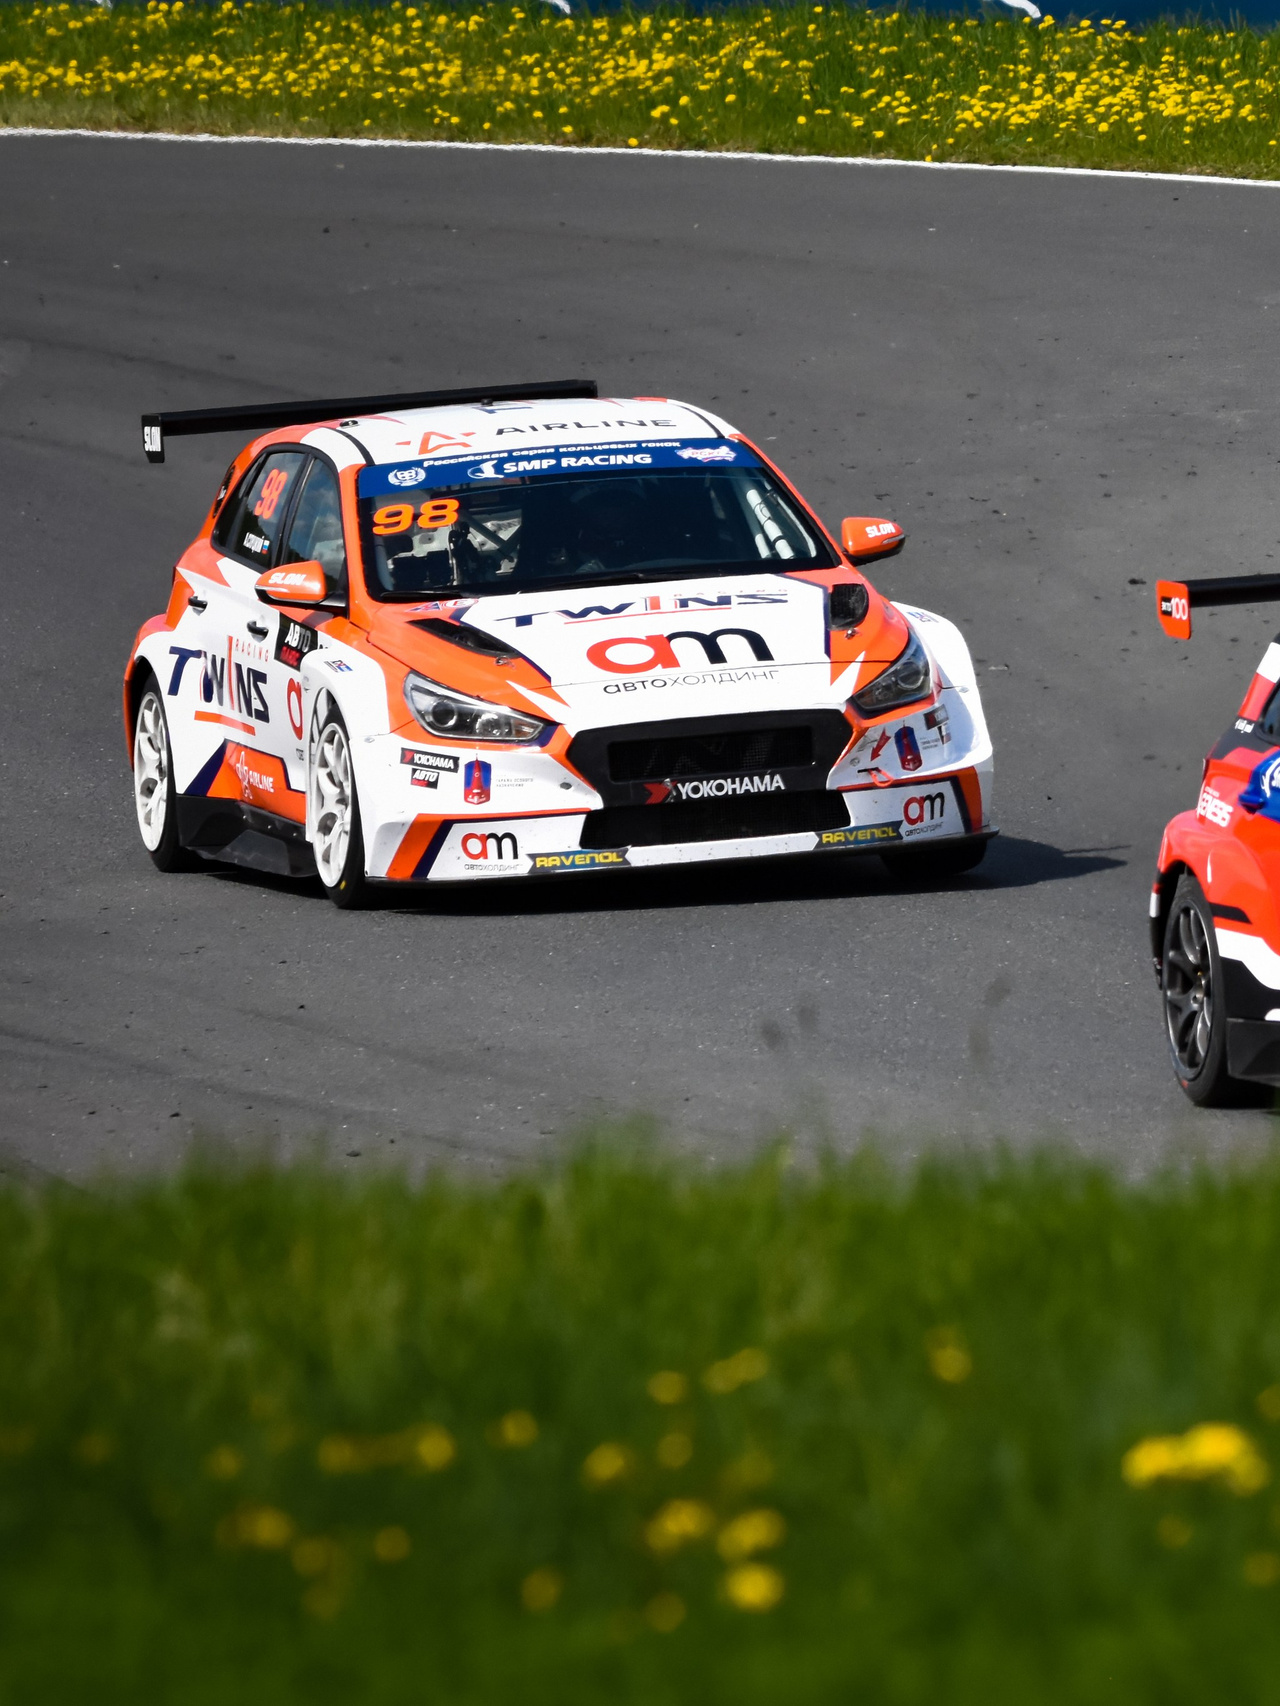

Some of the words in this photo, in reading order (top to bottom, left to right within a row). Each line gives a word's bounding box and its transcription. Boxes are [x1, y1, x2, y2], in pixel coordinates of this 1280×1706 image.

[496, 419, 677, 436] AIRLINE
[423, 451, 508, 467] Российская
[512, 446, 555, 457] серии
[641, 441, 681, 449] гонок
[503, 458, 557, 473] SMP
[561, 453, 652, 468] RACING
[254, 468, 288, 520] 98
[372, 498, 460, 536] 98
[494, 592, 789, 628] TWINS
[1171, 596, 1189, 621] 100
[234, 638, 270, 663] RACING
[284, 622, 312, 653] АВТО
[586, 627, 775, 674] am
[167, 635, 270, 724] TWINS
[603, 669, 780, 695] автохолдинг
[413, 752, 454, 769] YOKOHAMA
[412, 768, 438, 782] АВТО
[677, 774, 786, 800] YOKOHAMA
[903, 791, 946, 826] am
[461, 832, 519, 860] am
[821, 826, 897, 844] RAVENOL
[464, 862, 519, 872] автохолдинг
[535, 851, 624, 868] RAVENOL
